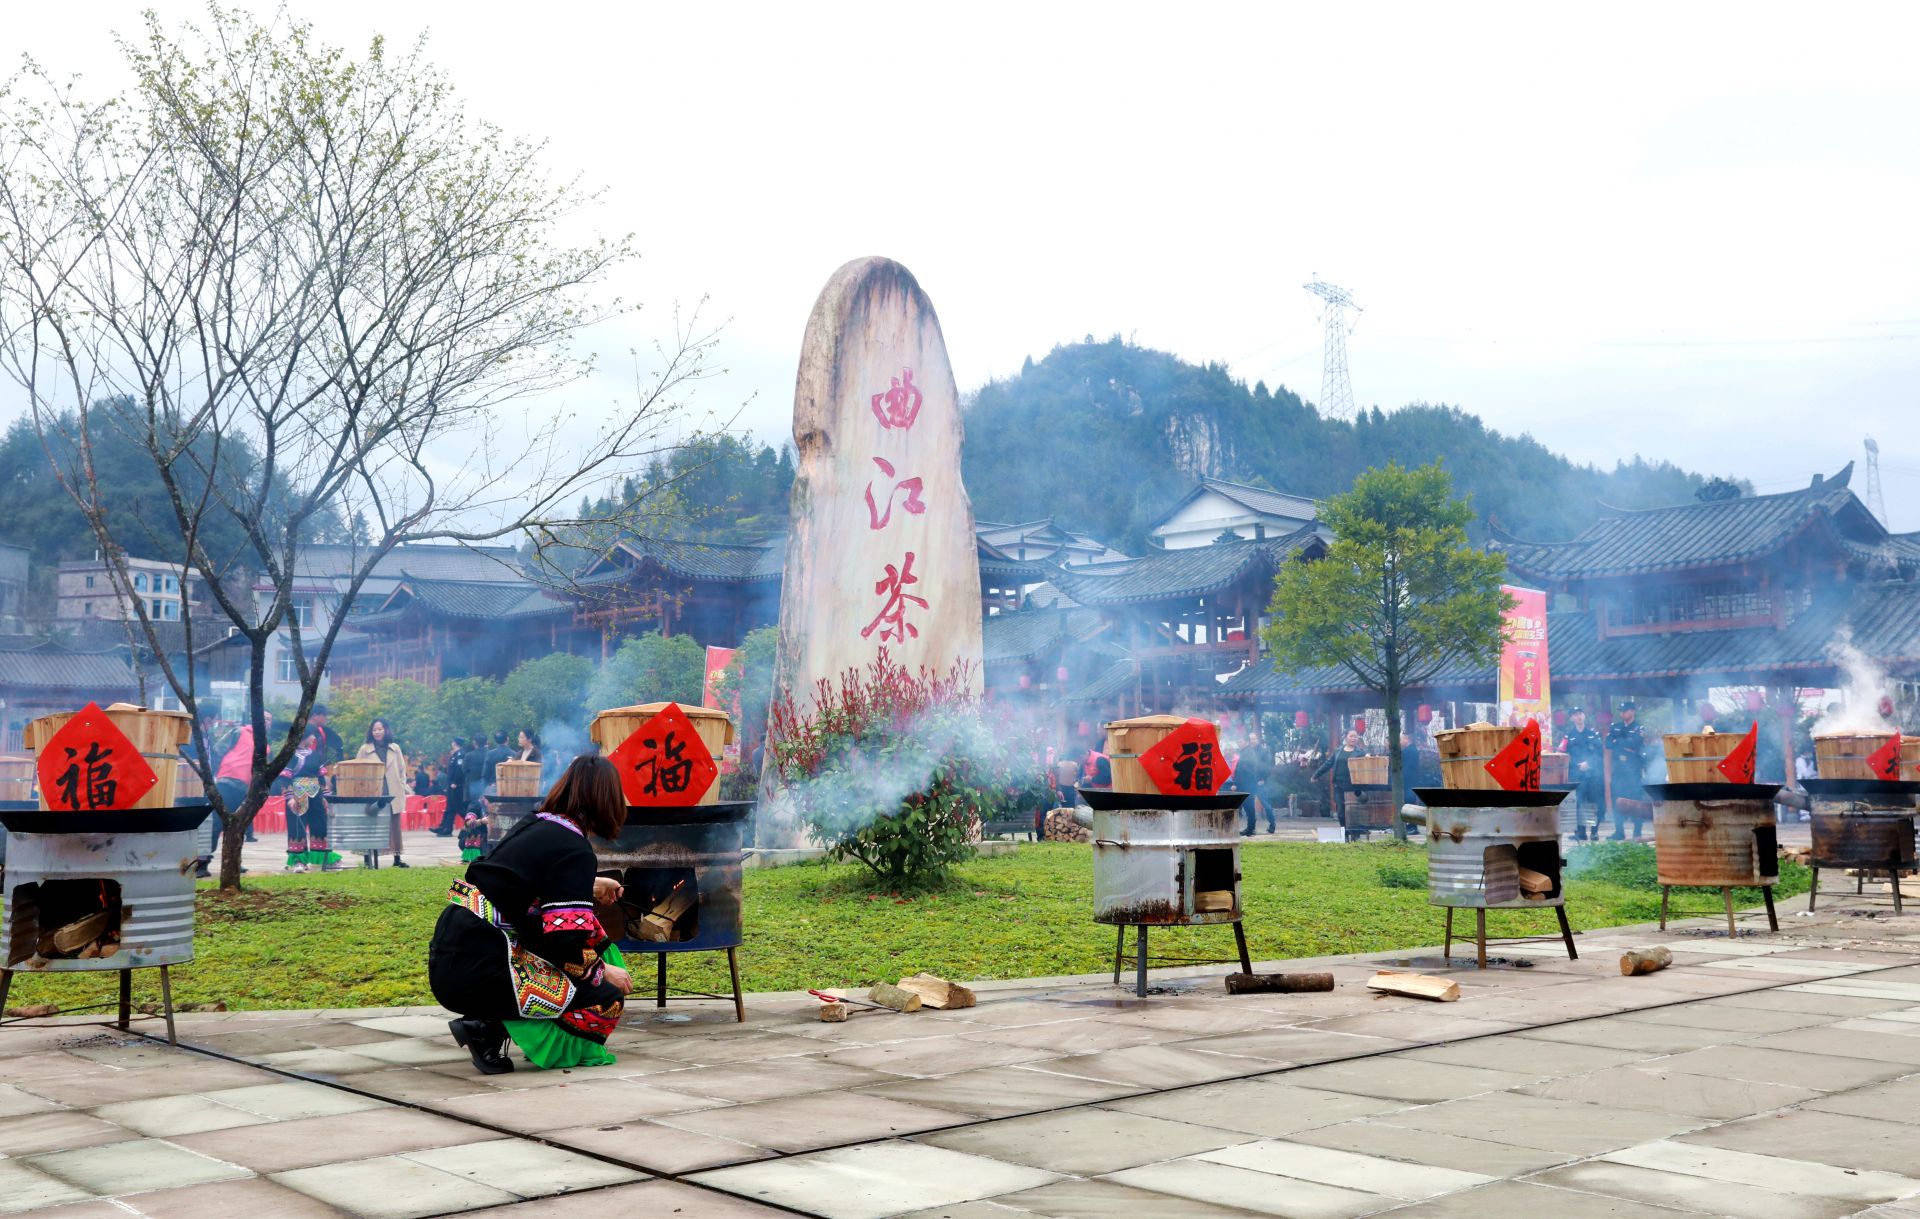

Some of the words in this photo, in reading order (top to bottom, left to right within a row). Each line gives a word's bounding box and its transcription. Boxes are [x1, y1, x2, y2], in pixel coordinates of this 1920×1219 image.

[861, 366, 929, 644] 曲江茶
[55, 741, 118, 811] 福
[635, 731, 694, 798] 福
[1172, 742, 1213, 791] 福
